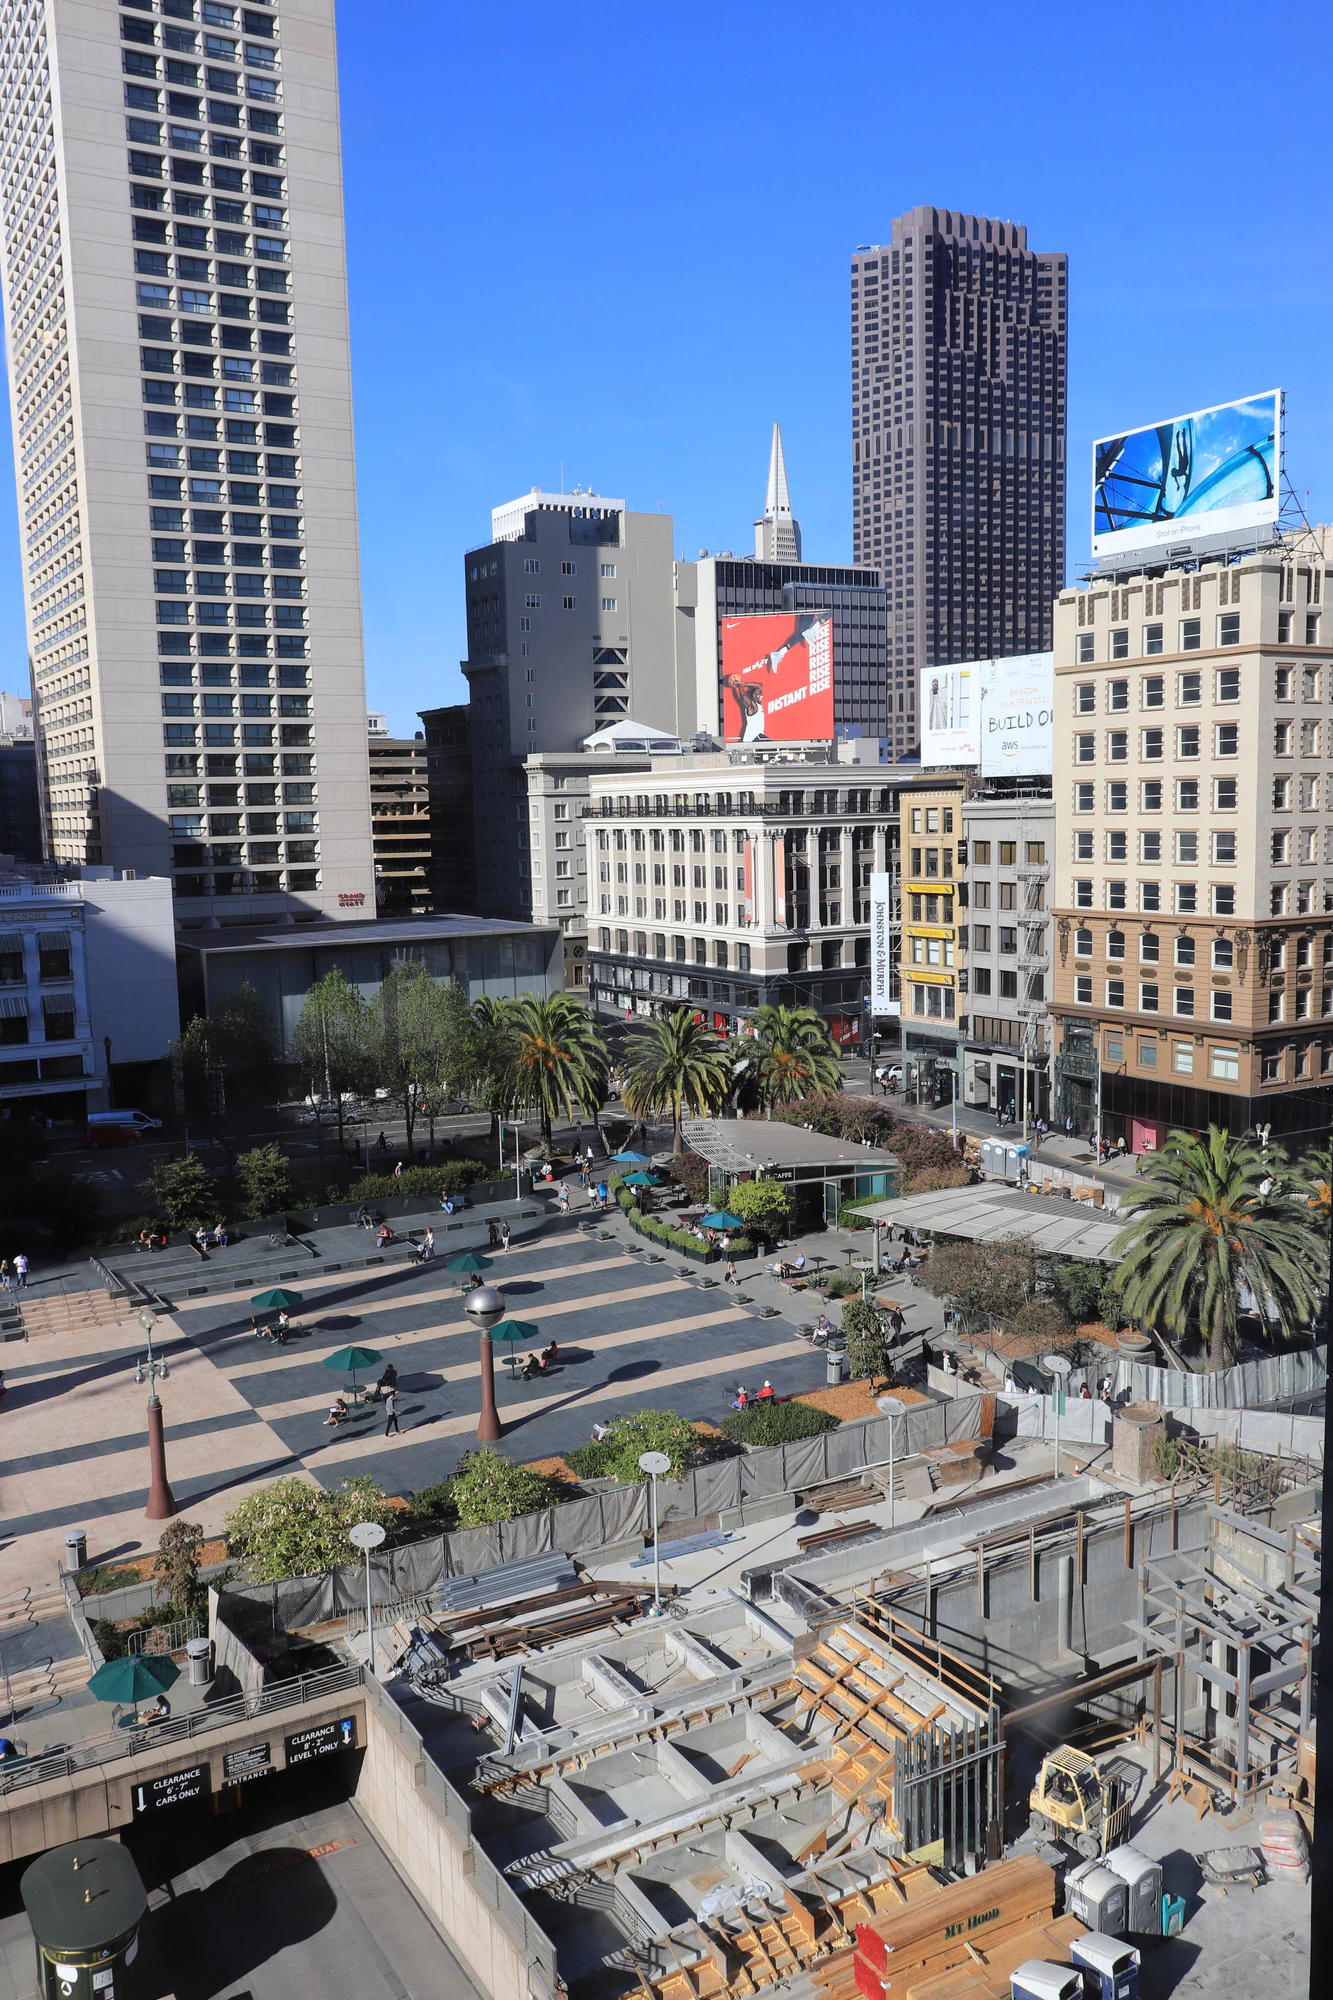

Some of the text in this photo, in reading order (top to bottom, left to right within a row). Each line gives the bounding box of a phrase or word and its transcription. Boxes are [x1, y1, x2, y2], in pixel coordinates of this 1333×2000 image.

[1156, 529, 1170, 538] Shot
[1180, 524, 1201, 534] iPhone
[810, 650, 830, 670] RISE
[810, 663, 830, 683] RISE
[768, 676, 830, 714] INSTANT RISE
[999, 695, 1050, 708] WEB SERVICES
[1010, 686, 1038, 698] AMAZON
[989, 710, 1053, 733] BUILD O
[1002, 740, 1018, 750] aws
[874, 901, 886, 998] JOHNSTON & MURPHY
[292, 1726, 335, 1745] CLEARANCE
[290, 1741, 338, 1764] LEVEL 1 ONLY
[153, 1768, 200, 1790] CLEARANCE
[228, 1769, 268, 1786] ENTRANCE
[156, 1786, 200, 1807] CARS ONLY
[968, 1908, 1000, 1930] HOOD
